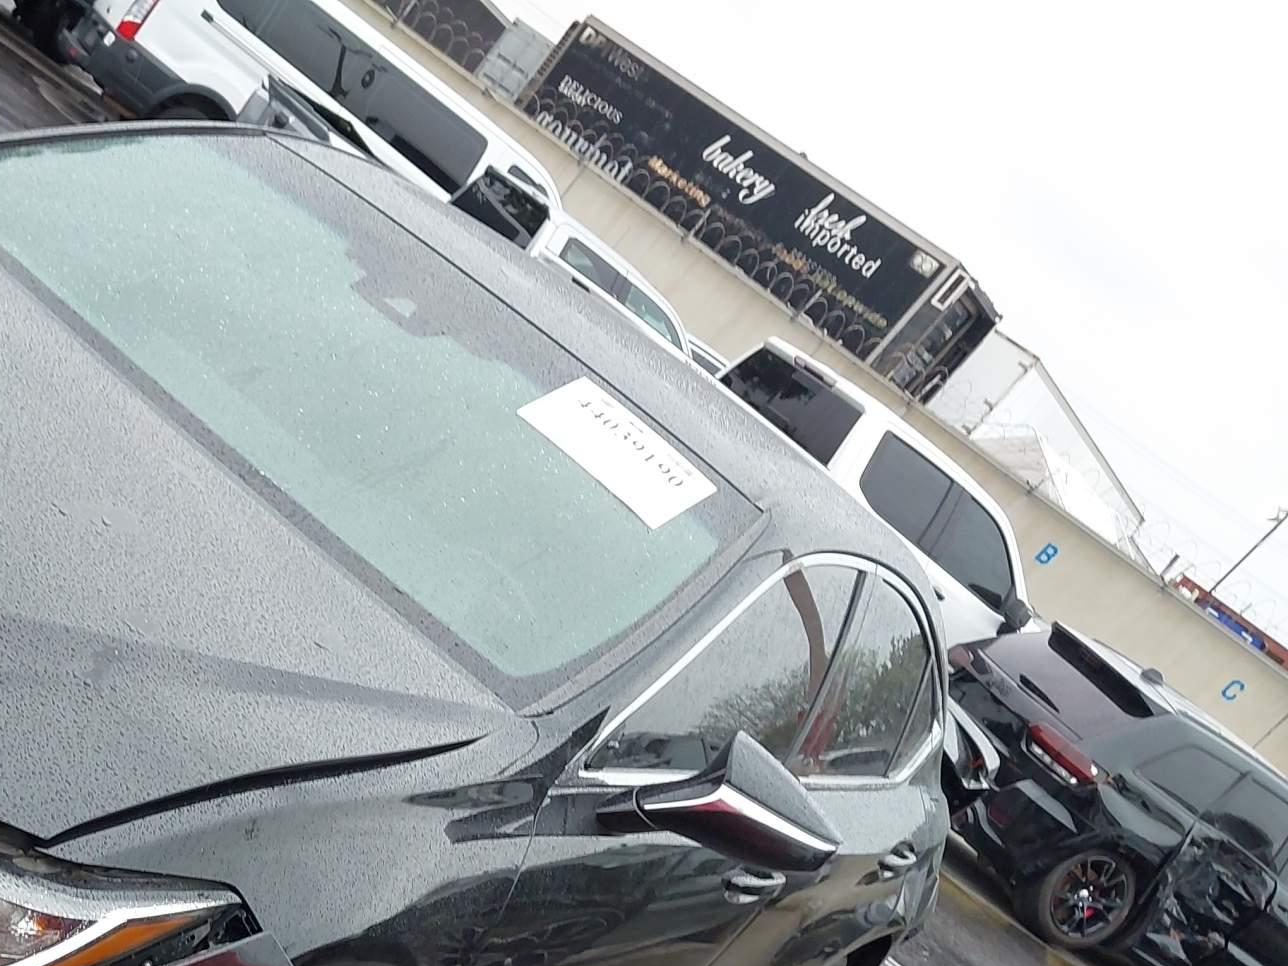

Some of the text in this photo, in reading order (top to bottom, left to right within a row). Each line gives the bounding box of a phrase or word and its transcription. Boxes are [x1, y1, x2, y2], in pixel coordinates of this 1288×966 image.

[702, 134, 776, 205] bakery
[794, 208, 882, 279] imported
[1034, 543, 1059, 565] B
[1221, 679, 1246, 701] C
